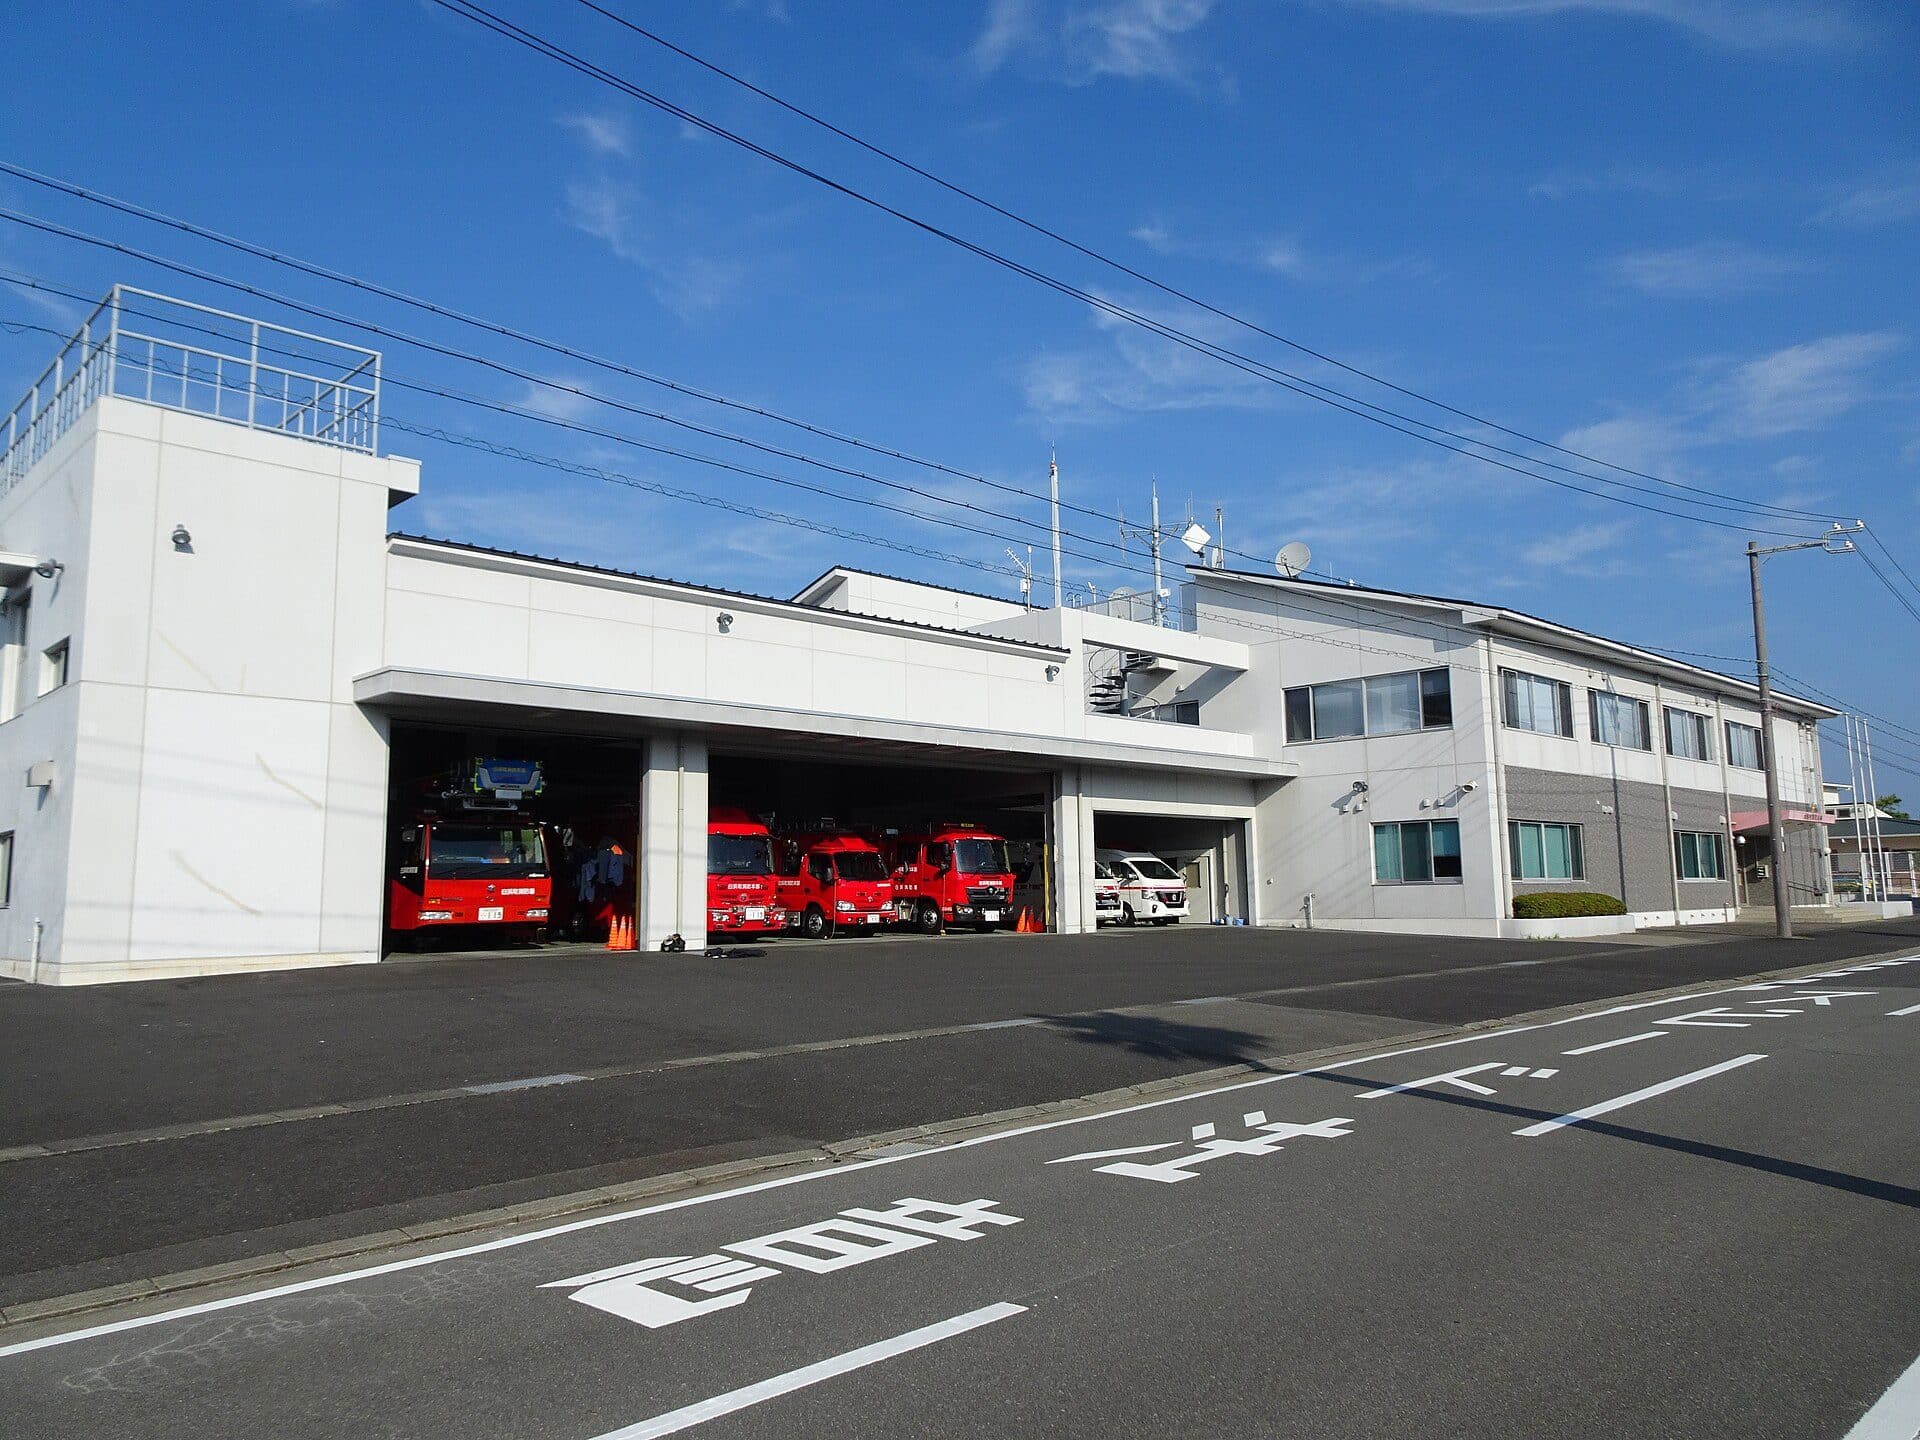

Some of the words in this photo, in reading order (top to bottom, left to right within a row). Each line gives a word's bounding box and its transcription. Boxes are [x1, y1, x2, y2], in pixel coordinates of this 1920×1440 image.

[536, 990, 1880, 1328] スピード注意
